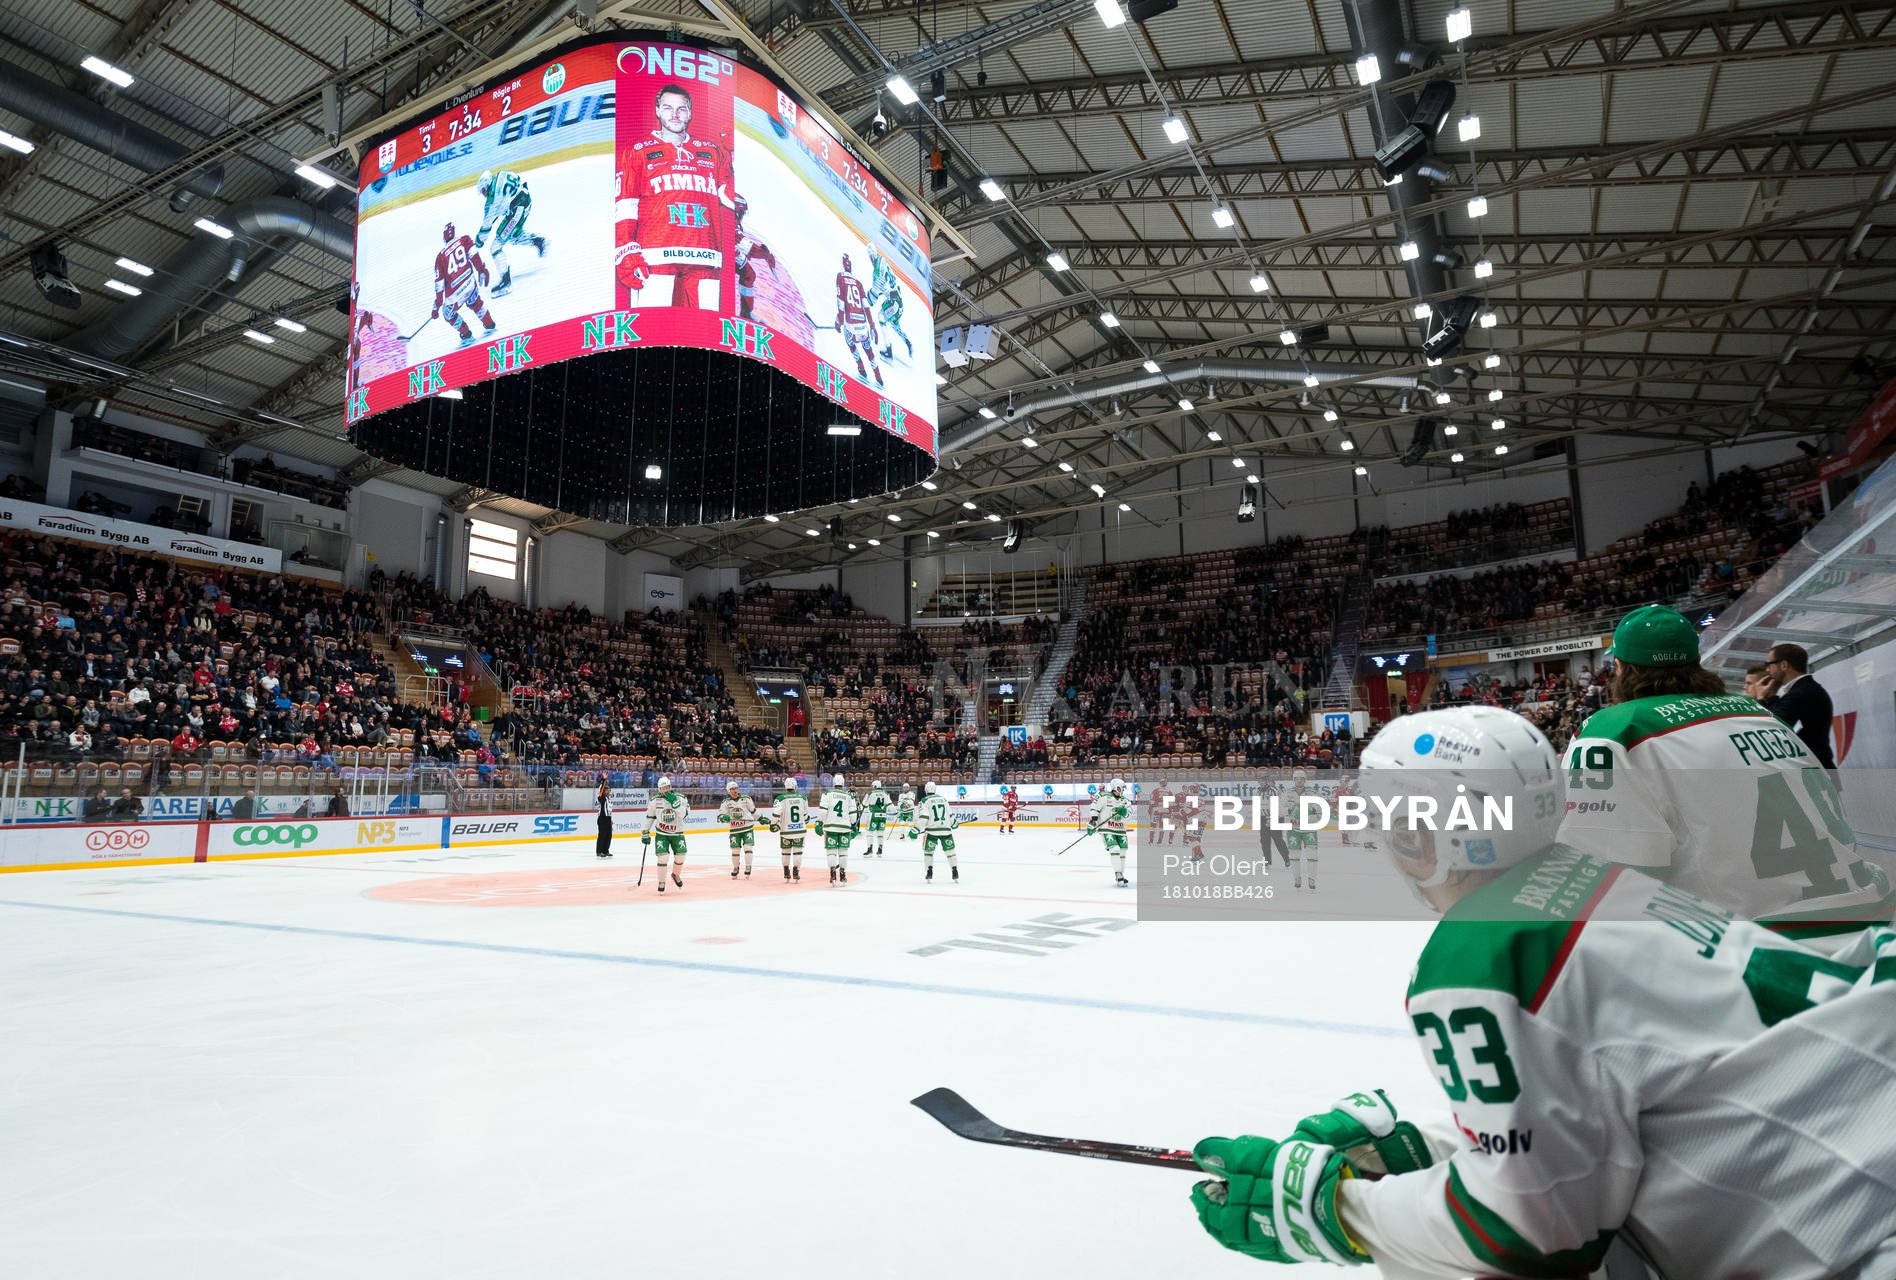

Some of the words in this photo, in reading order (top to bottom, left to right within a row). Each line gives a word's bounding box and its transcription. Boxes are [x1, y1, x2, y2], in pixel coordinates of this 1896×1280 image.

[511, 80, 522, 91] BK
[502, 95, 512, 117] 2
[449, 109, 482, 141] 7:34
[422, 134, 432, 153] 3
[650, 172, 718, 196] TIMRÅ
[843, 160, 869, 199] 7:34
[447, 244, 469, 275] 49
[663, 250, 716, 260] BILBOLAGET
[38, 518, 96, 535] Faradium
[100, 529, 130, 543] Bygg
[132, 536, 150, 545] AB
[170, 542, 218, 557] Faradium
[222, 551, 247, 564] Bygg
[249, 556, 265, 565] AB
[1514, 648, 1541, 657] POWER
[1556, 640, 1594, 651] MOBILITY
[1434, 747, 1464, 764] Bank
[790, 805, 800, 823] 6
[833, 800, 843, 818] 4
[932, 804, 946, 822] 17
[1535, 791, 1556, 819] 33
[532, 815, 580, 834] SSE
[659, 823, 677, 831] MAXI
[997, 814, 1039, 822] Fdium
[357, 821, 396, 845] NP3
[452, 822, 519, 835] BAUER
[1412, 1006, 1522, 1104] 33
